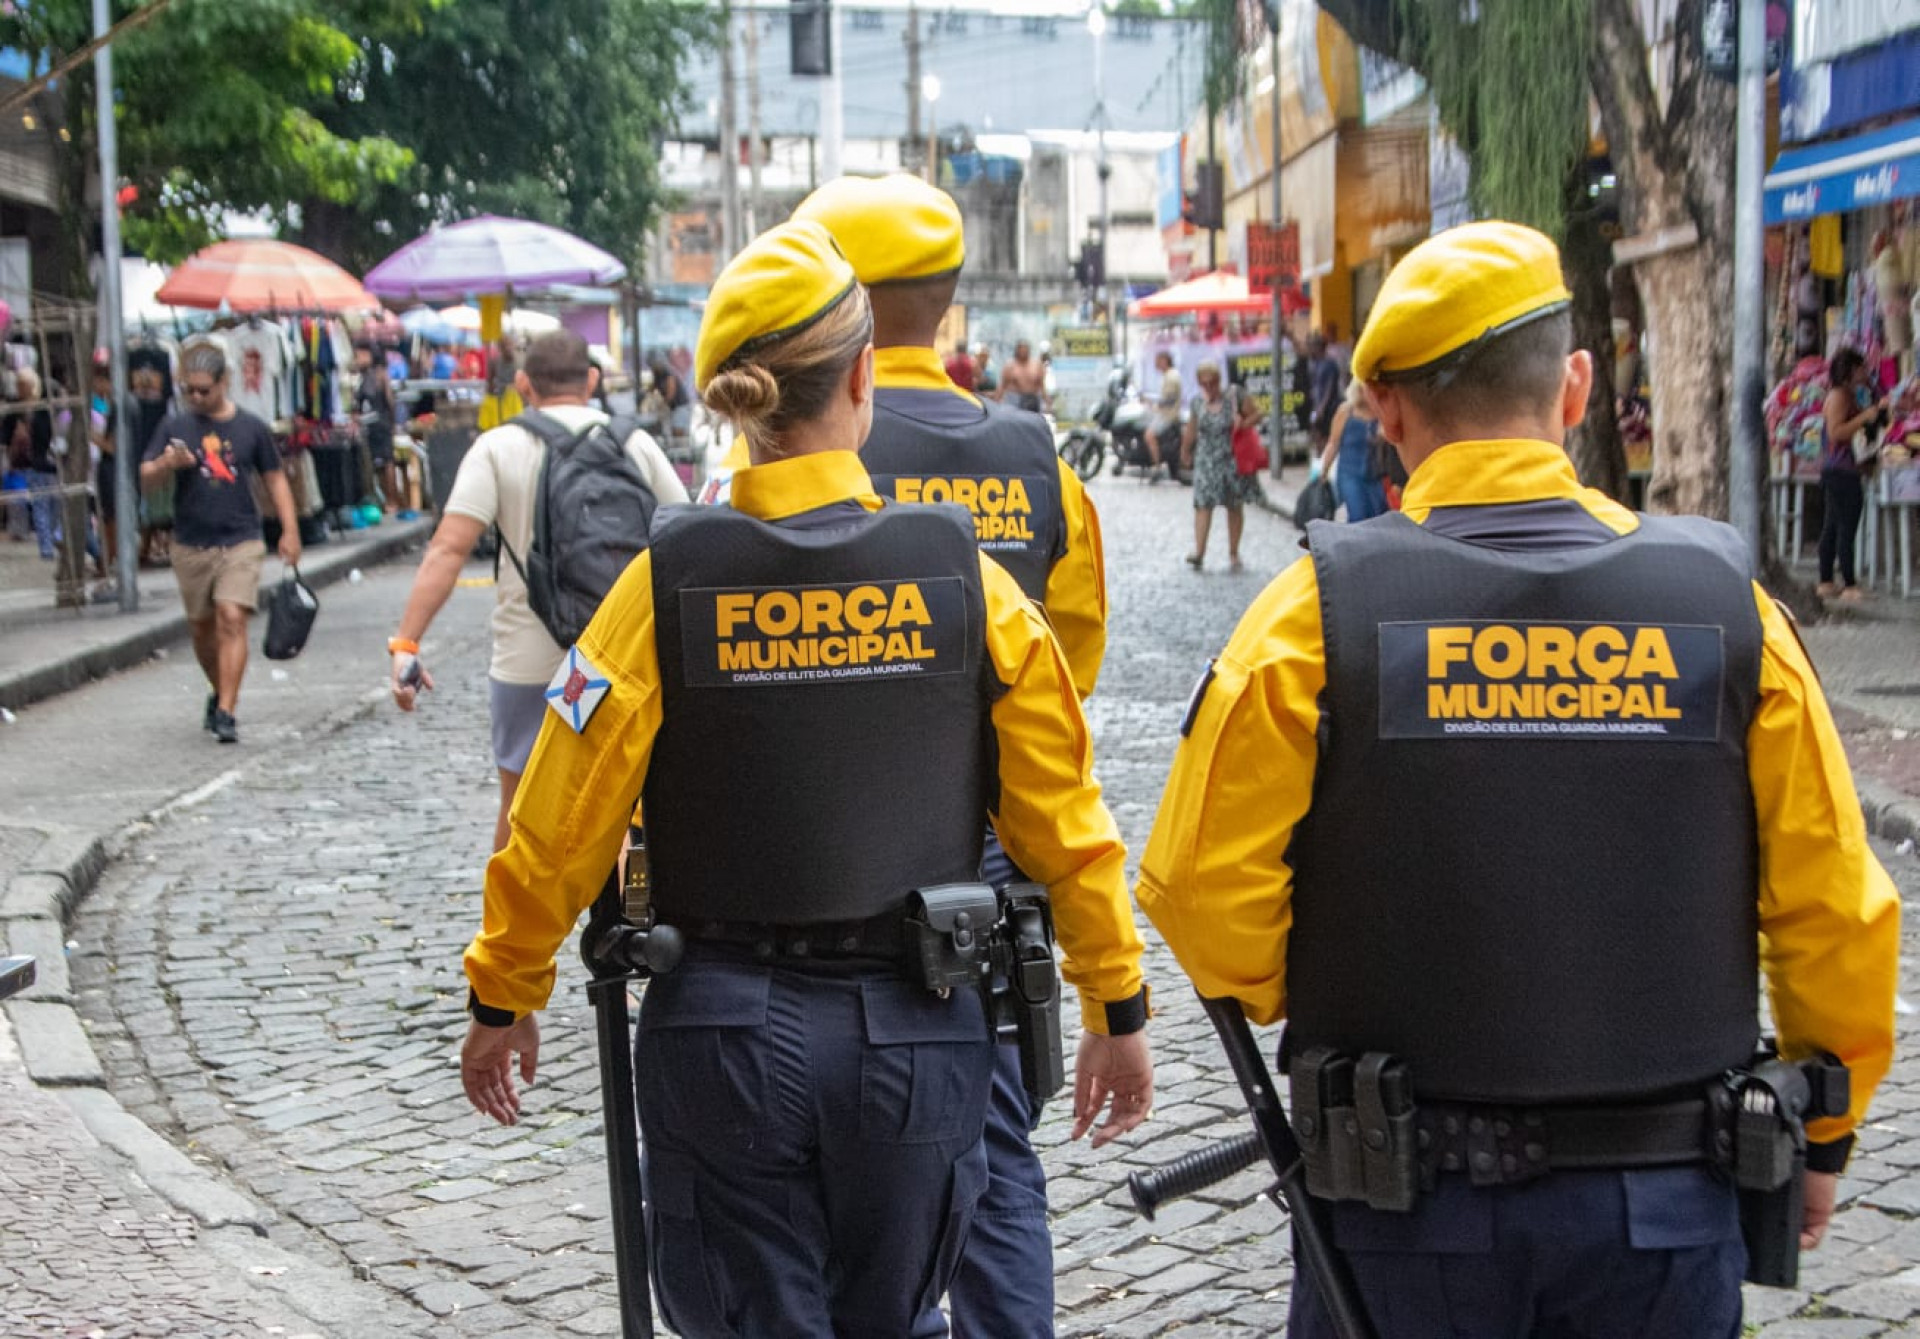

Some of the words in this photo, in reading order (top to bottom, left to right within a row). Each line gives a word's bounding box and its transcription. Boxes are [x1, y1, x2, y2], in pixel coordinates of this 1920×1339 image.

[895, 477, 1032, 516] FORÇA
[716, 583, 933, 637] FORÇA
[717, 630, 936, 671] MUNICIPAL
[1427, 625, 1680, 685] FORÇA
[733, 670, 772, 682] DIVISÃO
[774, 672, 787, 681] DE
[789, 671, 816, 680] ELITE
[817, 669, 830, 678] DA
[832, 667, 872, 678] GUARDA
[873, 662, 924, 675] MUNICIPAL
[1427, 683, 1682, 719] MUNICIPAL
[1444, 720, 1491, 733] DIVISÃO
[1492, 722, 1508, 733] DE
[1509, 722, 1541, 733] ELITE
[1541, 722, 1558, 733] DA
[1559, 722, 1607, 733] GUARDA
[1607, 722, 1668, 733] MUNICIPAL
